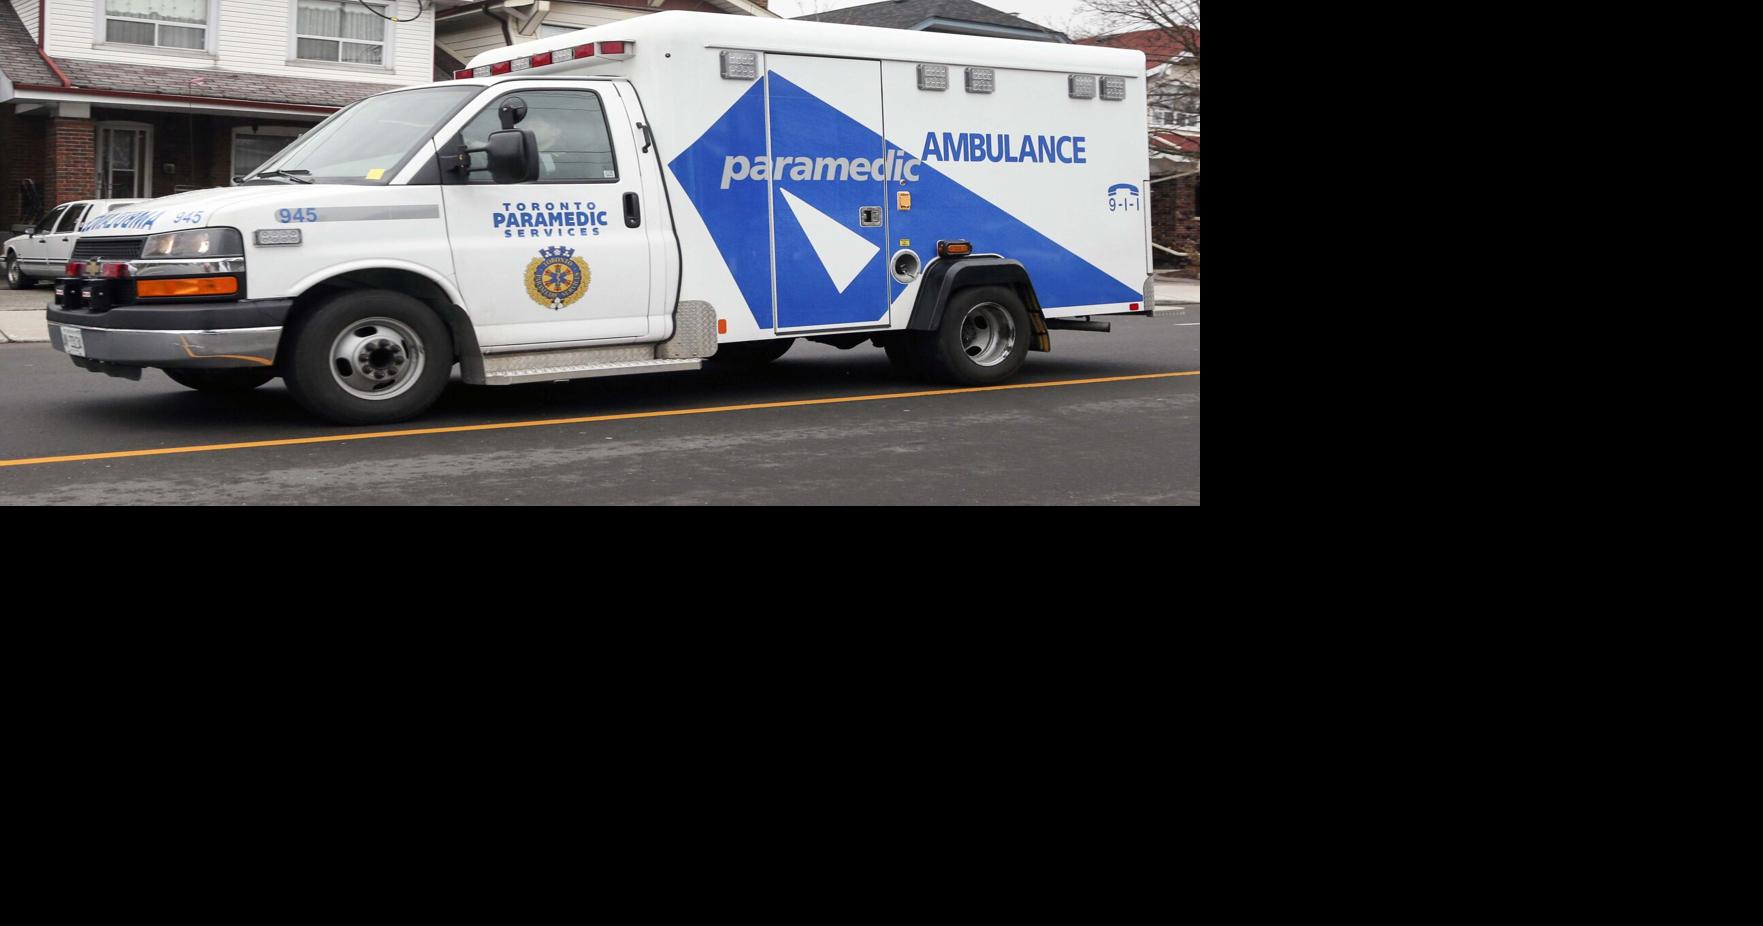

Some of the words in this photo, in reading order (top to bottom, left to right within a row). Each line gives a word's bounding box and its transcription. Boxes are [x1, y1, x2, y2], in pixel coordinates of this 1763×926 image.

[921, 131, 1087, 164] AMBULANCE
[720, 149, 921, 190] paramedic
[502, 202, 596, 211] TORONTO
[1108, 197, 1140, 212] 9-1-1
[173, 210, 204, 224] 945
[279, 207, 318, 224] 945
[493, 210, 608, 229] PARAMEDIC
[504, 227, 600, 238] SERVICES
